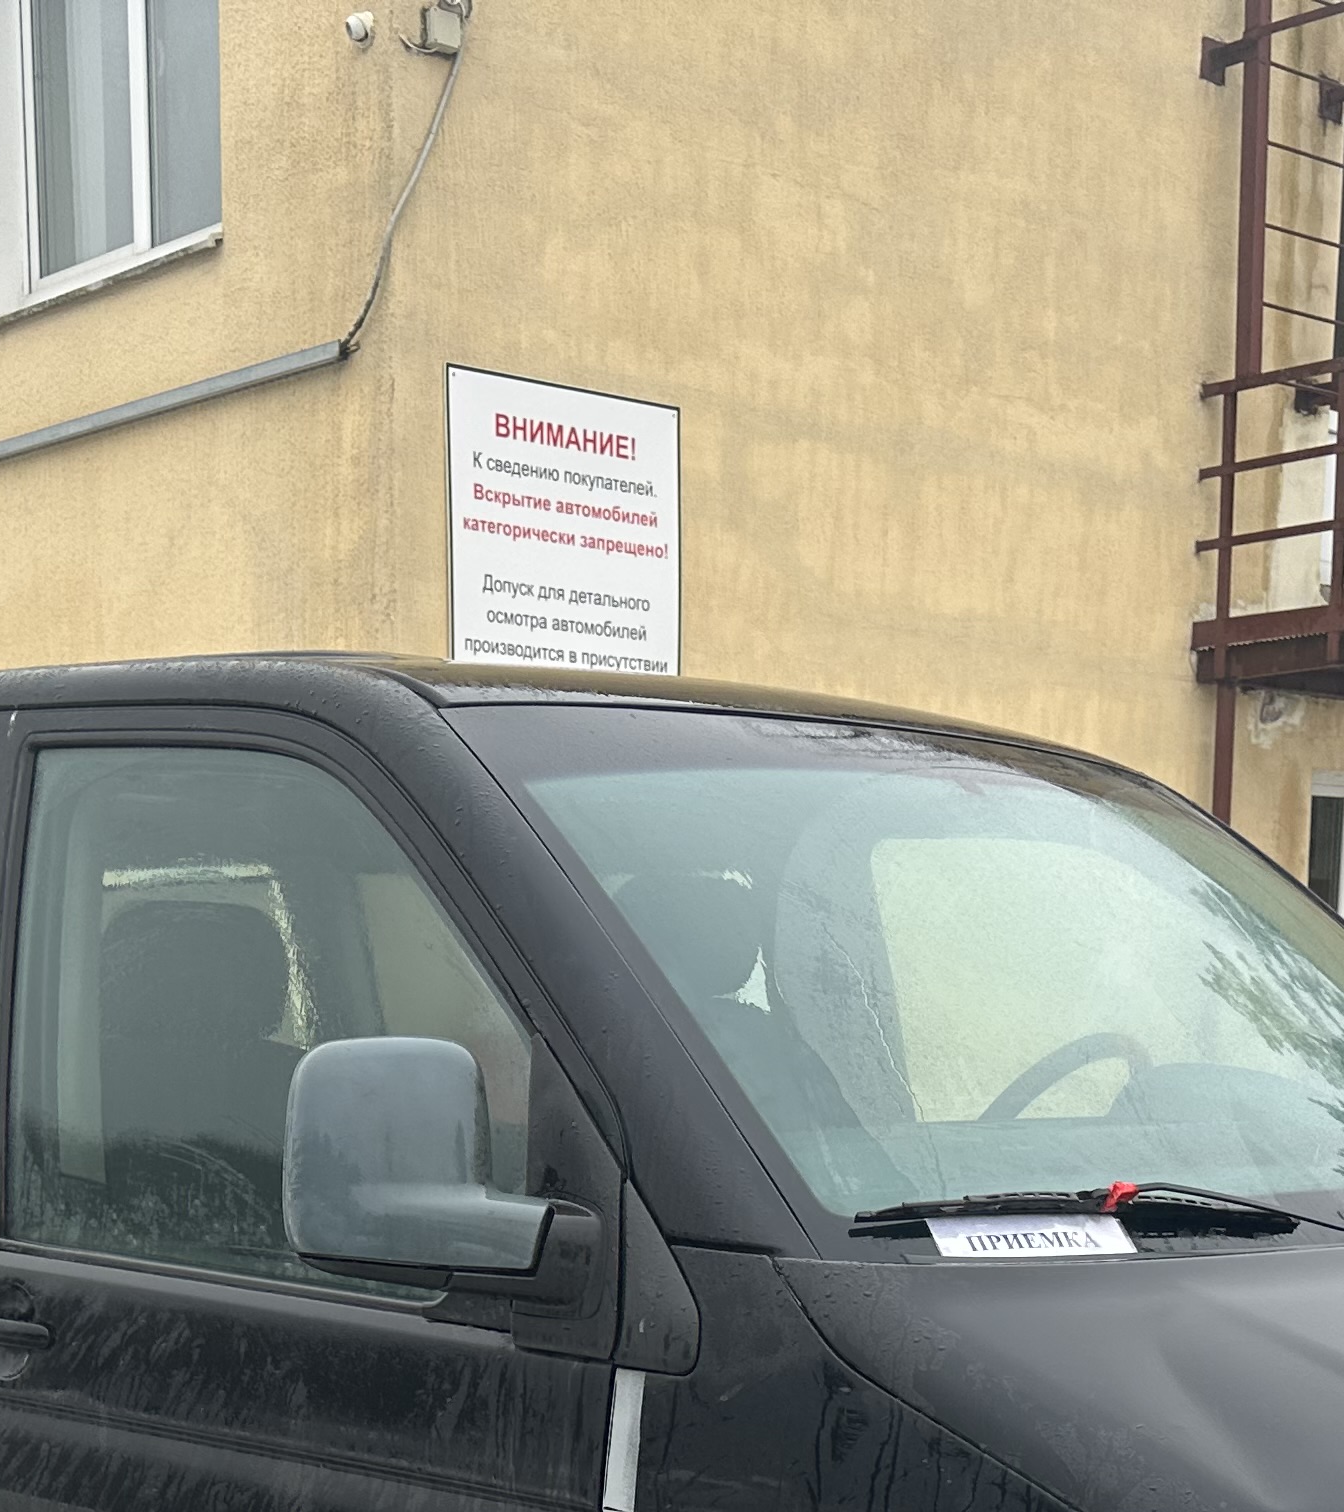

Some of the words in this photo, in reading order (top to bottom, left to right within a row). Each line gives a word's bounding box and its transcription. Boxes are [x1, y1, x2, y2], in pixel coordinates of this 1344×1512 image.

[494, 412, 637, 461] ВНИМАНИЕ!
[472, 450, 483, 469] К
[486, 456, 560, 482] сведению
[563, 469, 658, 498] покупателей.
[473, 482, 552, 512] Вскрытие
[555, 499, 658, 528] автомобилей
[462, 516, 576, 546] категорически
[579, 534, 669, 560] запрещено!
[482, 573, 535, 599] Допуск
[537, 585, 566, 602] для
[568, 589, 651, 612] детального
[486, 608, 548, 633] осмотра
[551, 617, 648, 642] автомобилей
[464, 637, 565, 661] производится
[568, 650, 578, 664] в
[581, 651, 669, 674] присутствии
[965, 1230, 1102, 1252] ПРИЕМКА
